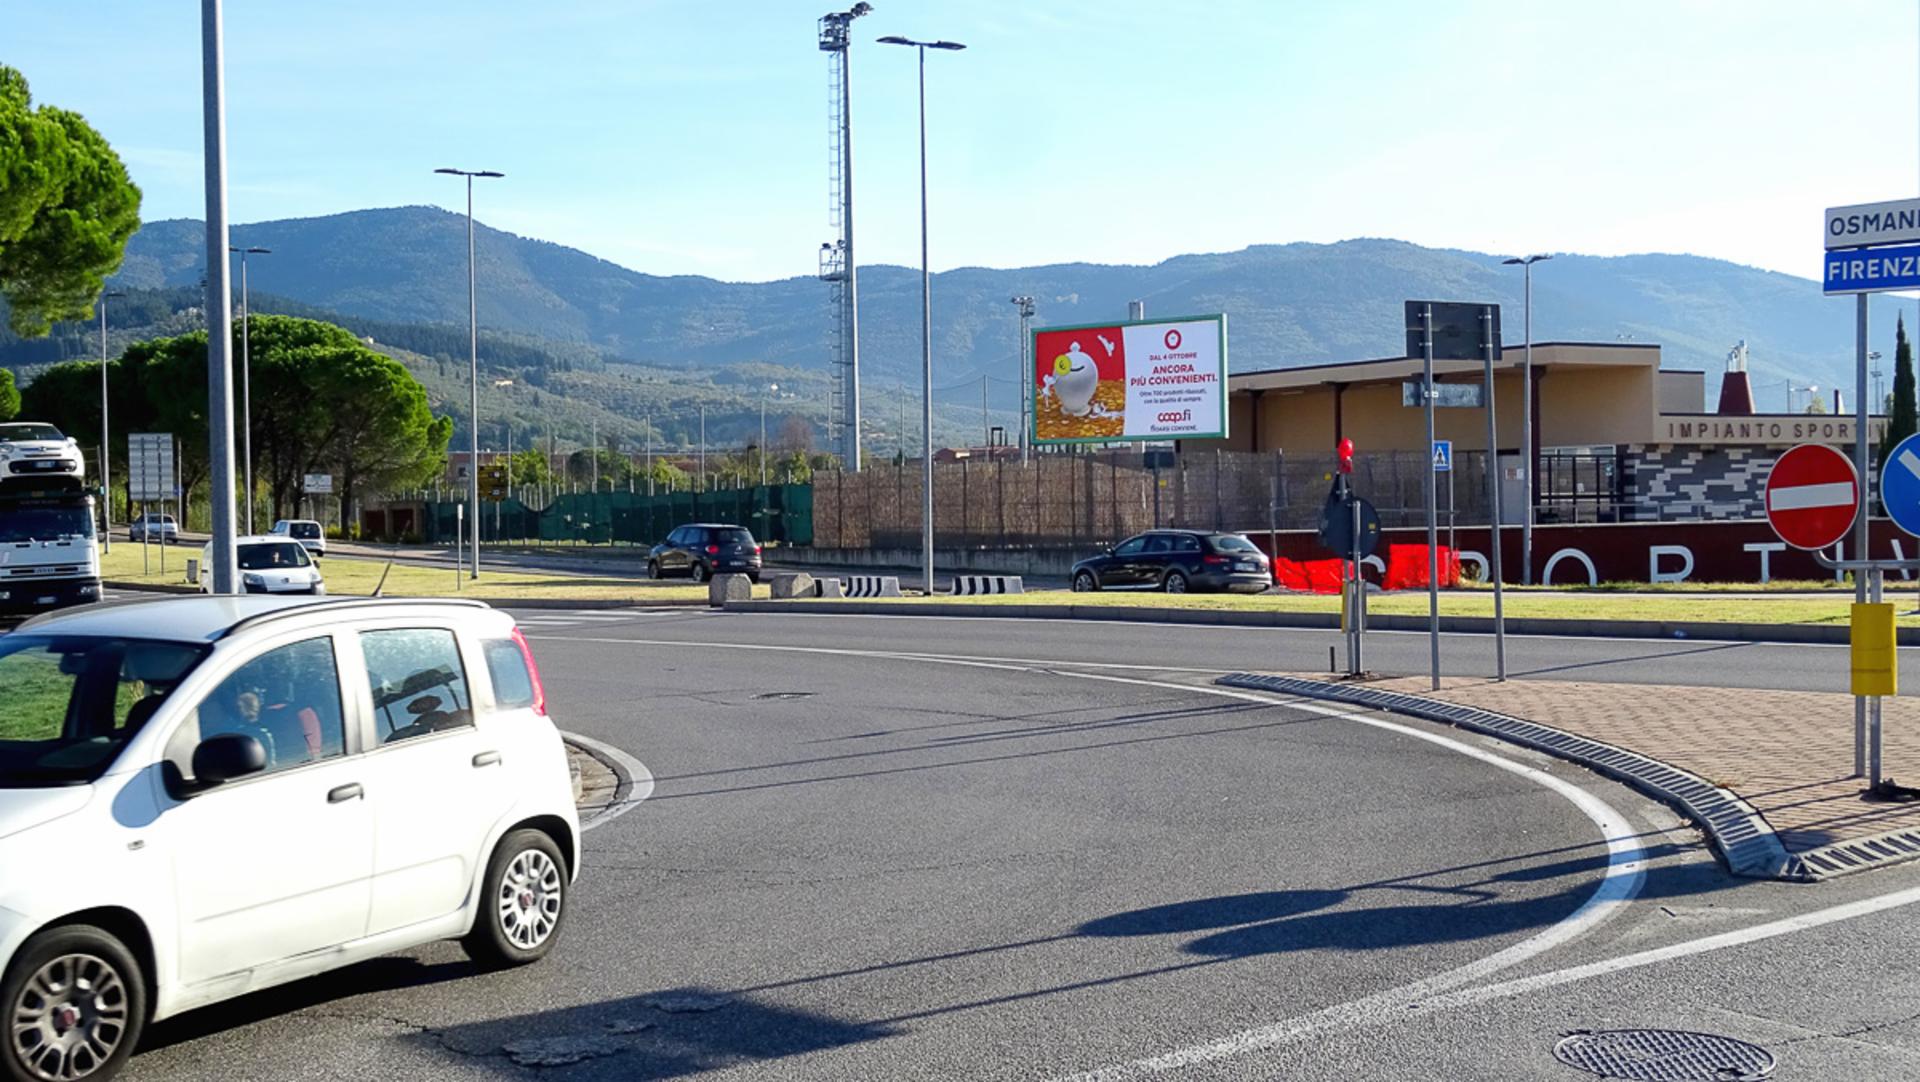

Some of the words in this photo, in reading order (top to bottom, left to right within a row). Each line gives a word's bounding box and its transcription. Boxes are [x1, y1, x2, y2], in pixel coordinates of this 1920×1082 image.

[1168, 352, 1197, 360] OTTOBRE
[1153, 364, 1194, 374] ANCORA
[1130, 376, 1146, 386] PIÙ
[1148, 374, 1218, 385] CONVENIENTI.
[1668, 423, 1782, 439] IMPIANTO
